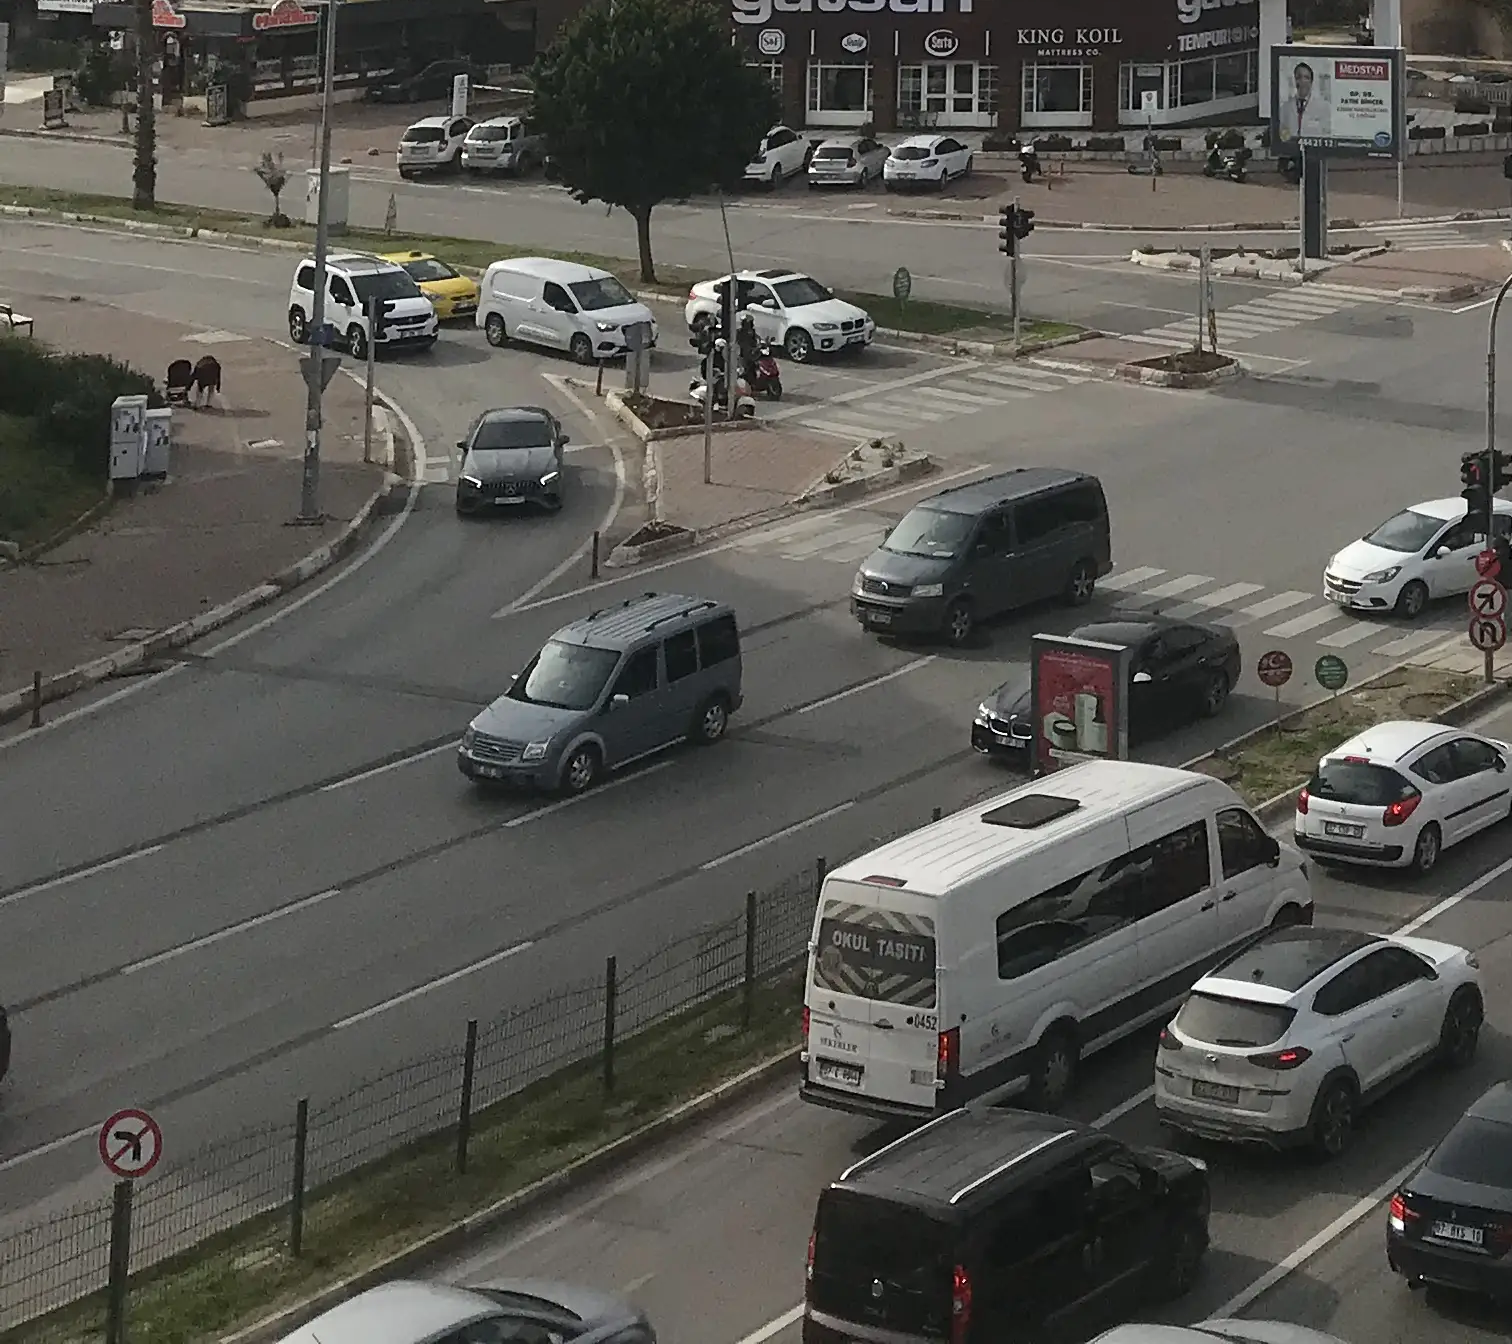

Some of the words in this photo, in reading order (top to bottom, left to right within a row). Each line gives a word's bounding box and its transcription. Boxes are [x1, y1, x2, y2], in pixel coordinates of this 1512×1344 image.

[931, 34, 954, 50] Serta
[1017, 28, 1064, 45] KING
[1077, 28, 1123, 44] KOIL
[1177, 28, 1229, 52] TEMPUR
[1037, 48, 1082, 56] MATTRESS
[1086, 48, 1102, 56] CO.
[1339, 63, 1384, 75] MEDSTAR
[832, 930, 871, 953] OKUL
[914, 1015, 938, 1031] 0452
